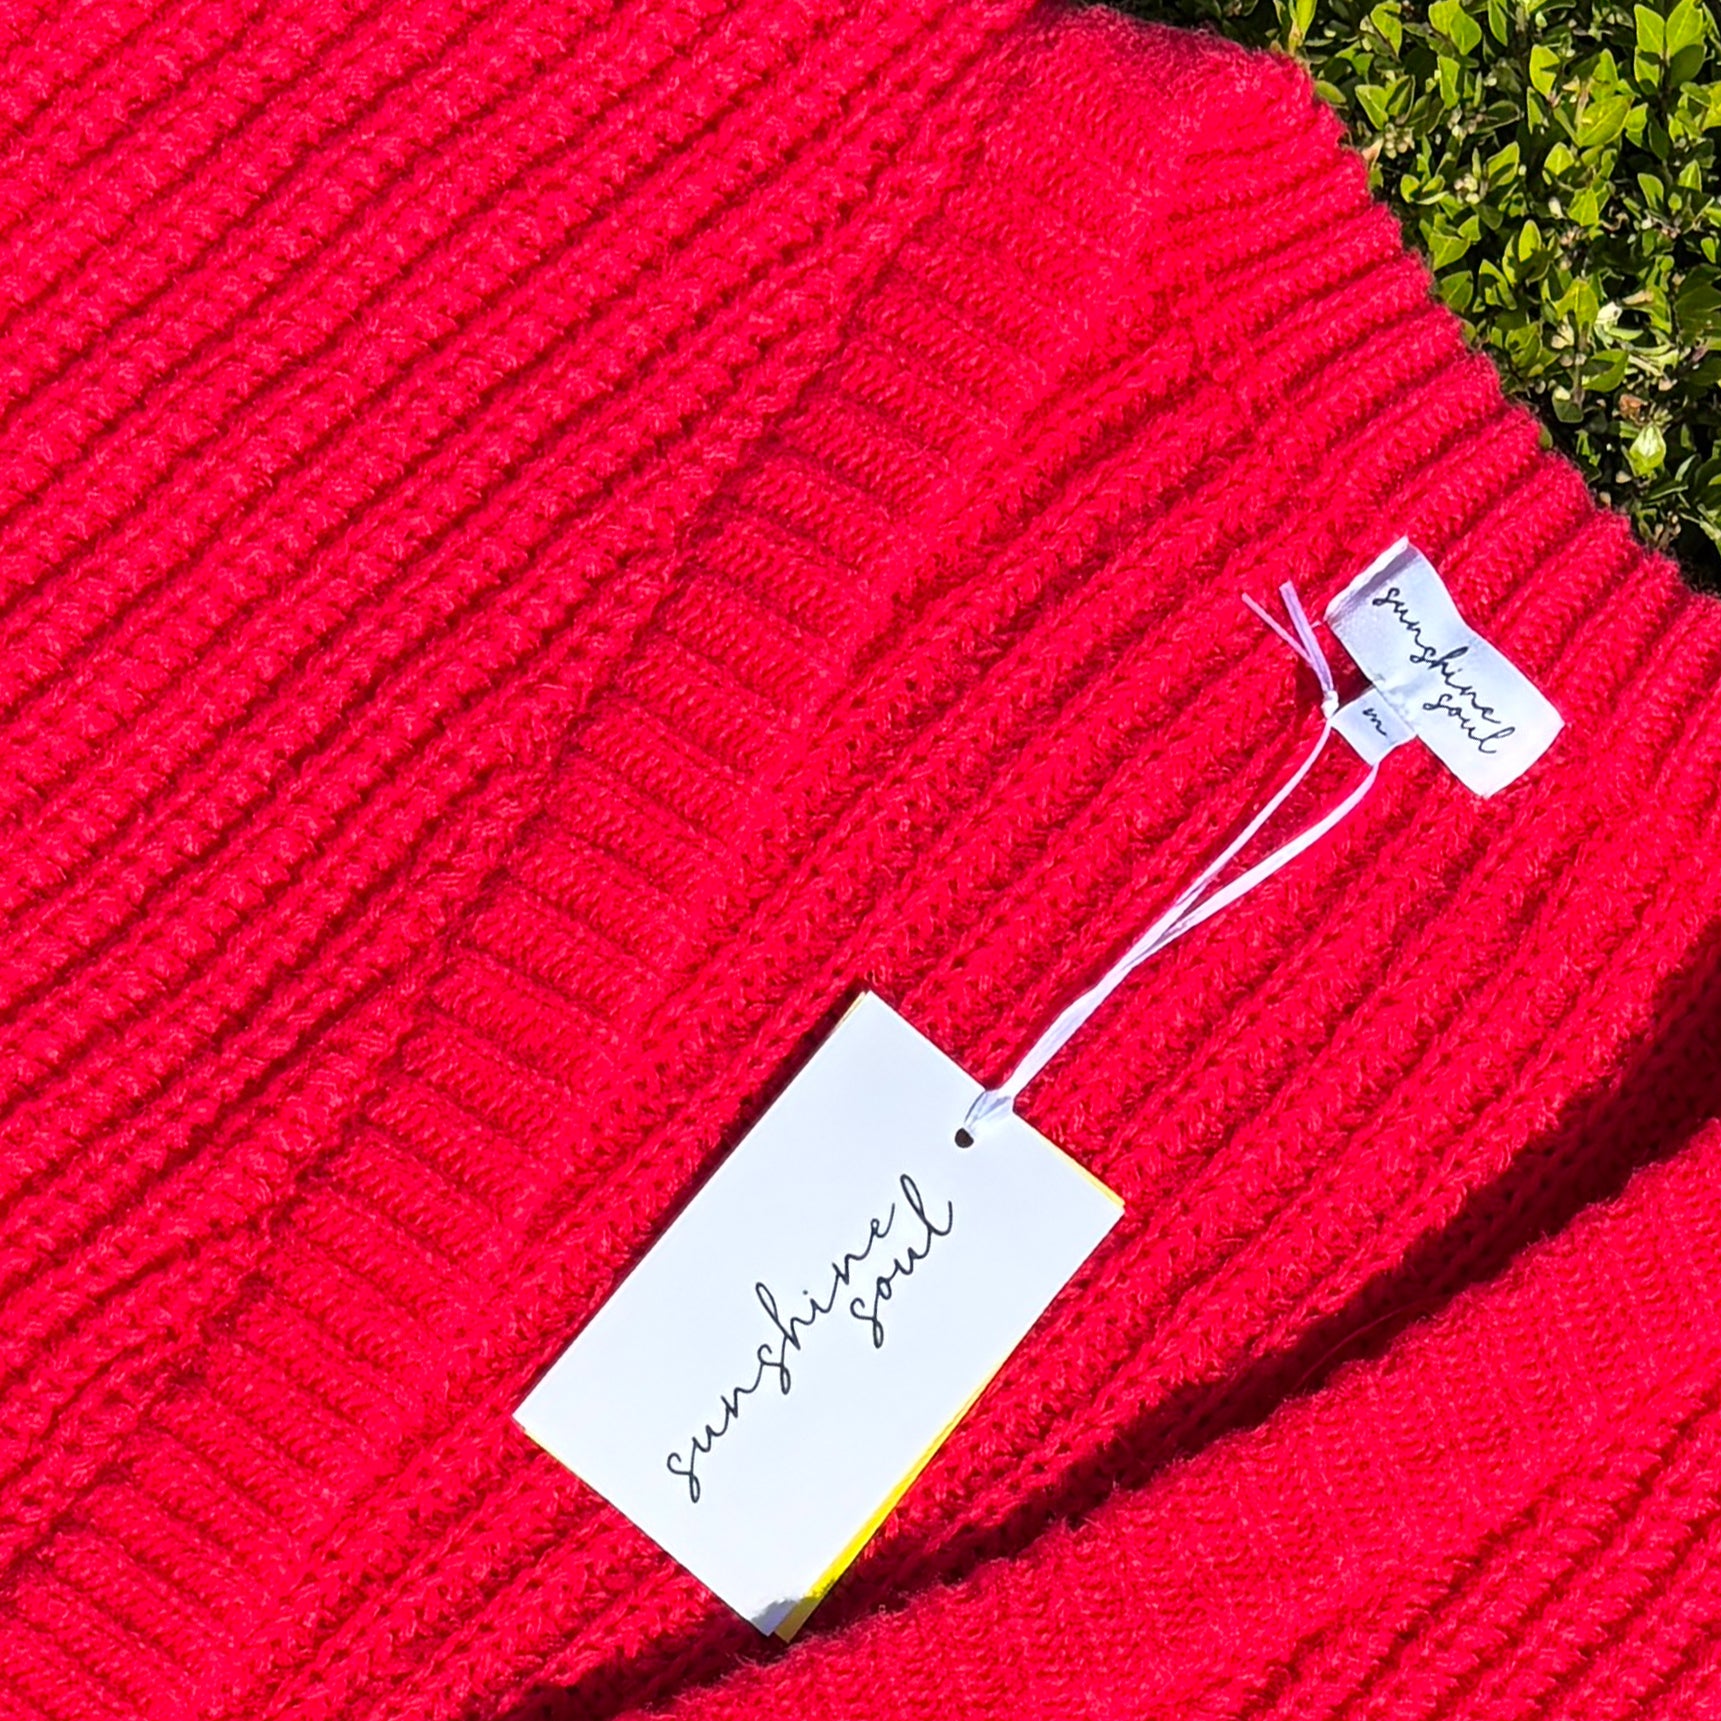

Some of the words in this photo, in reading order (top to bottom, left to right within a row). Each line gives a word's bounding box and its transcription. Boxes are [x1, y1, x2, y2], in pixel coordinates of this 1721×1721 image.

[1373, 588, 1501, 724] sunshine
[1423, 694, 1514, 753] soul
[850, 1174, 953, 1348] soul
[667, 1203, 895, 1503] sunshine
